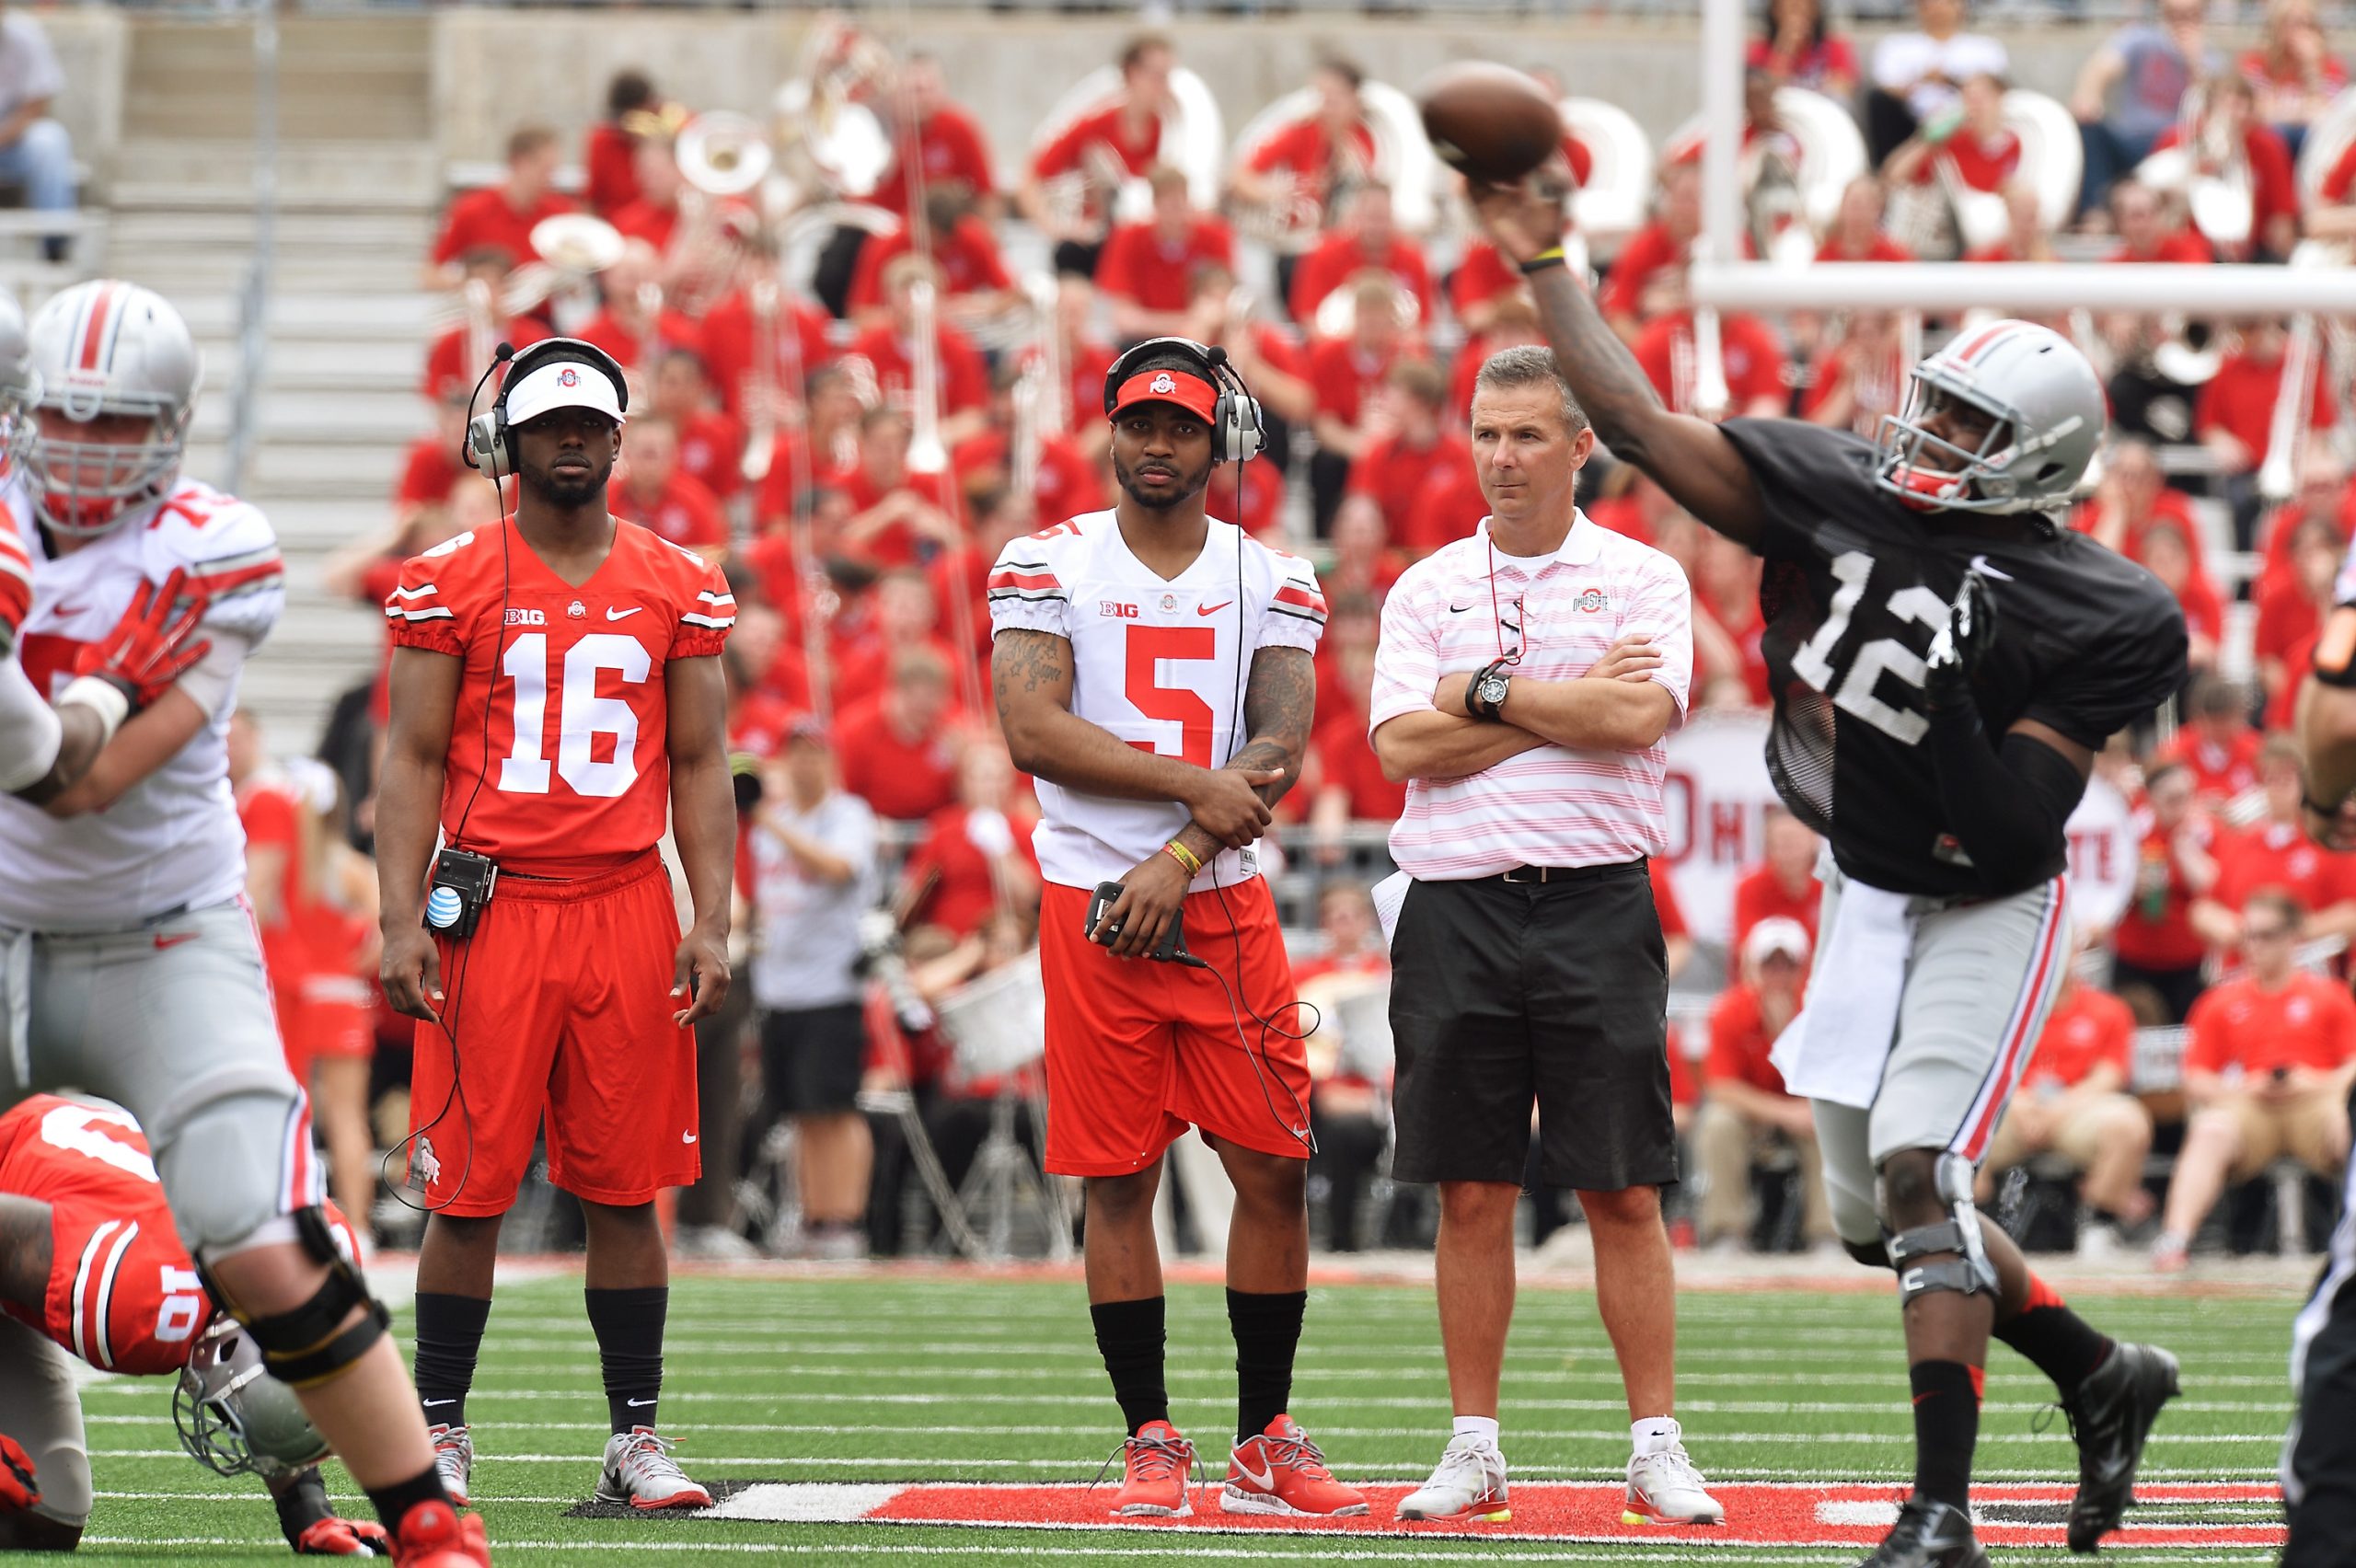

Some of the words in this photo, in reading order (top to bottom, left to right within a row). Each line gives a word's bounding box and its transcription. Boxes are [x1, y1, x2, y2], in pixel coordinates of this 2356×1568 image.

[1573, 596, 1588, 612] OHIO
[1588, 594, 1608, 611] STATE
[1790, 550, 1952, 746] 12
[498, 632, 652, 798] 16
[1126, 624, 1215, 771] 5
[155, 1264, 204, 1343] 10
